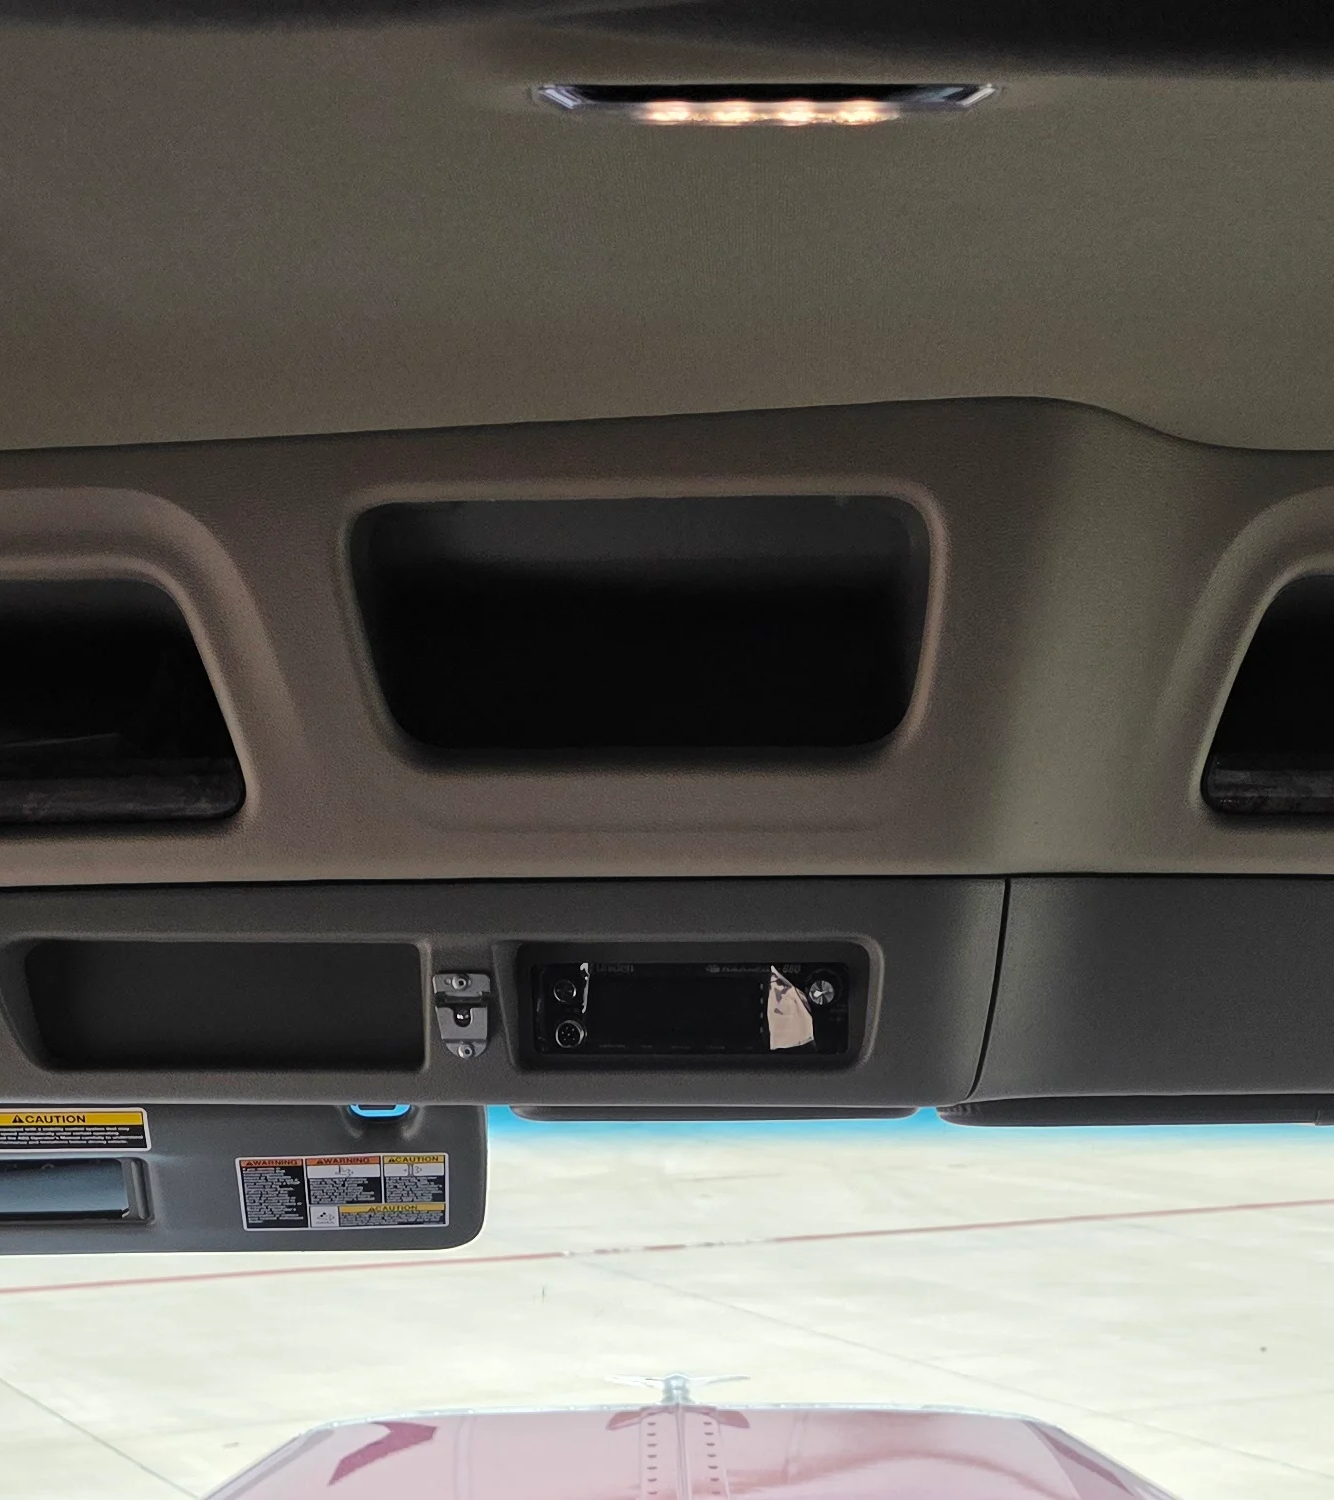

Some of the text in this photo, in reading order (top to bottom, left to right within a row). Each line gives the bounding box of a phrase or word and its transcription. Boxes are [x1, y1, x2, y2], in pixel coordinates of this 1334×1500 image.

[25, 1114, 87, 1124] CAUTION
[324, 1157, 371, 1165] WARNING
[394, 1155, 439, 1163] CAUTION
